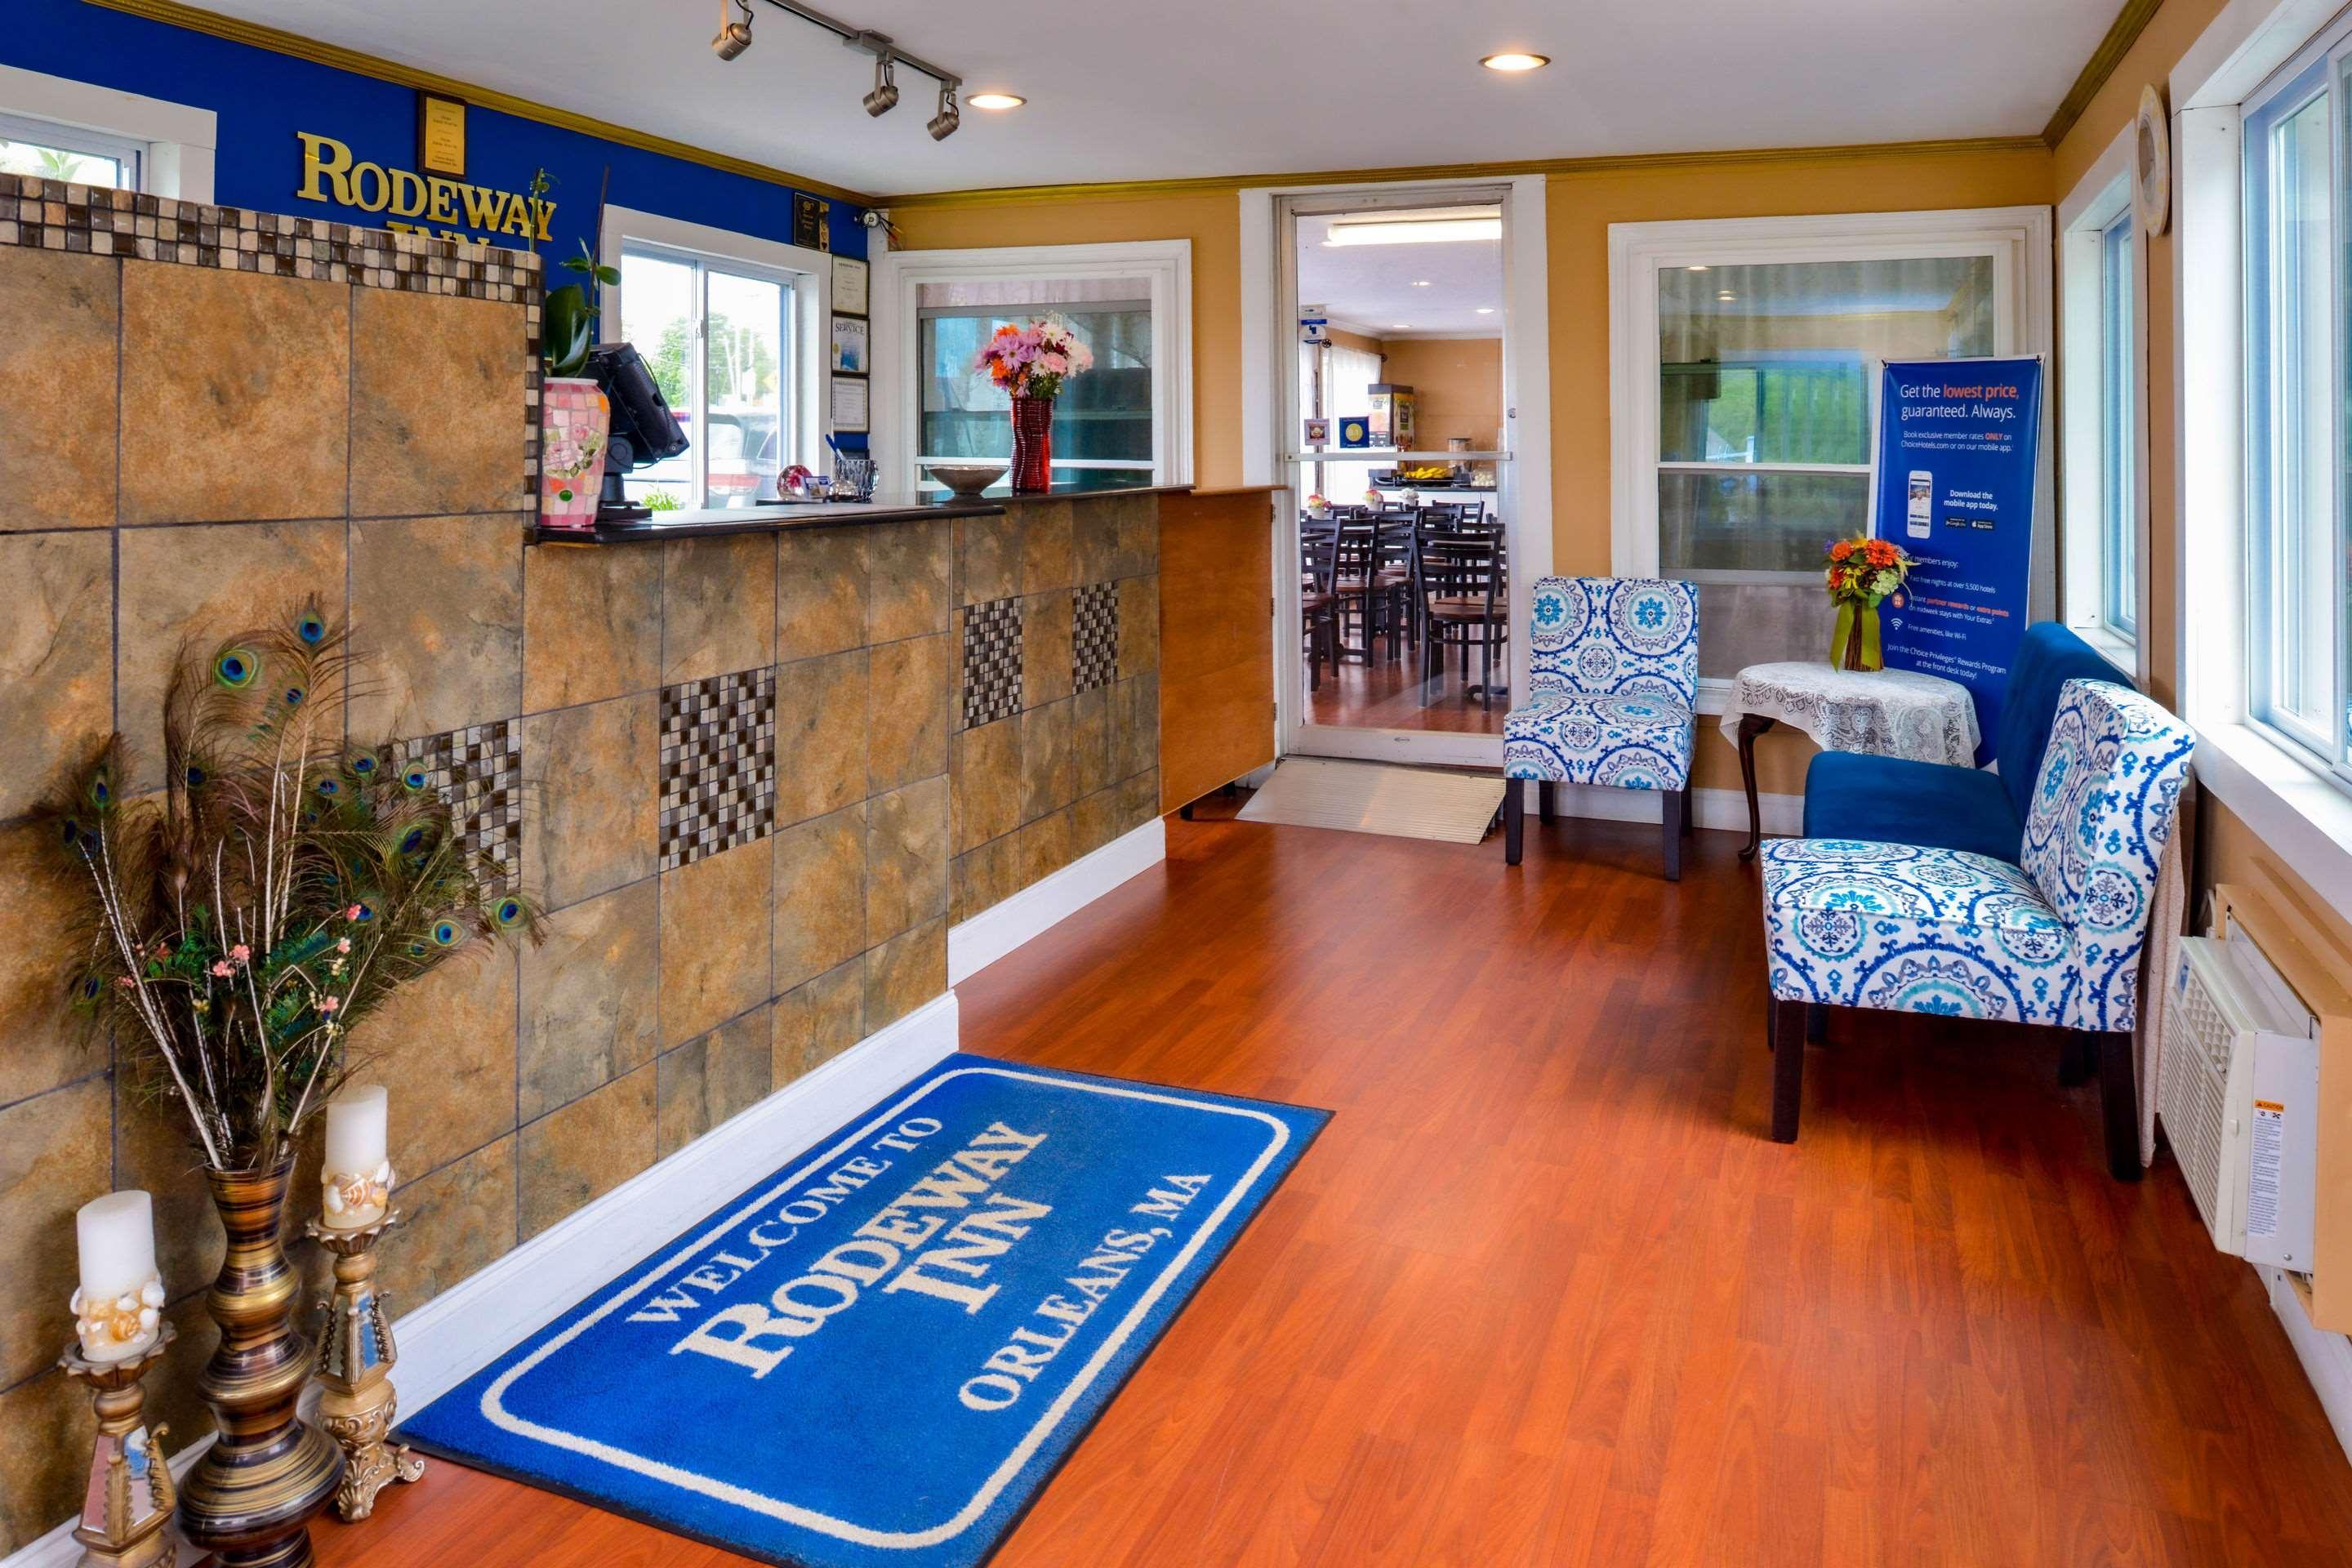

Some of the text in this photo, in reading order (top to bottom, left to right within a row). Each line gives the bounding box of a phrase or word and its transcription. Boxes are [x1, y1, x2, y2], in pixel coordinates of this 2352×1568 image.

[296, 131, 557, 242] RODEWAY
[835, 323, 864, 336] SERVICE
[1901, 385, 1919, 399] Get
[1922, 385, 1940, 398] the
[1944, 384, 1982, 399] lowest
[1901, 403, 2016, 422] guaranteed. Always.
[1901, 440, 1949, 449] ChoiceHotels.com
[1978, 443, 1999, 451] mobile
[1950, 490, 1993, 500] Download the
[1944, 499, 1998, 511] mobile app today.
[1914, 556, 1941, 565] members
[1931, 578, 1947, 587] nights
[1980, 586, 1996, 594] hotels
[1917, 607, 1938, 615] midweek
[1939, 611, 1952, 619] stays
[1964, 613, 1976, 621] Your
[1953, 632, 1967, 641] Wi-Fi
[1887, 644, 1899, 652] Join
[1900, 645, 1909, 654] the
[1910, 648, 1928, 657] Choice
[1958, 657, 1981, 669] Rewards
[1982, 662, 2007, 675] Program
[1932, 662, 1946, 671] front
[1946, 666, 1959, 675] desk
[625, 1116, 943, 1325] WELCOME TO
[669, 1120, 1049, 1380] RODEWAY
[880, 1192, 1054, 1316] INN
[957, 1173, 1214, 1412] ORLEANS, MA
